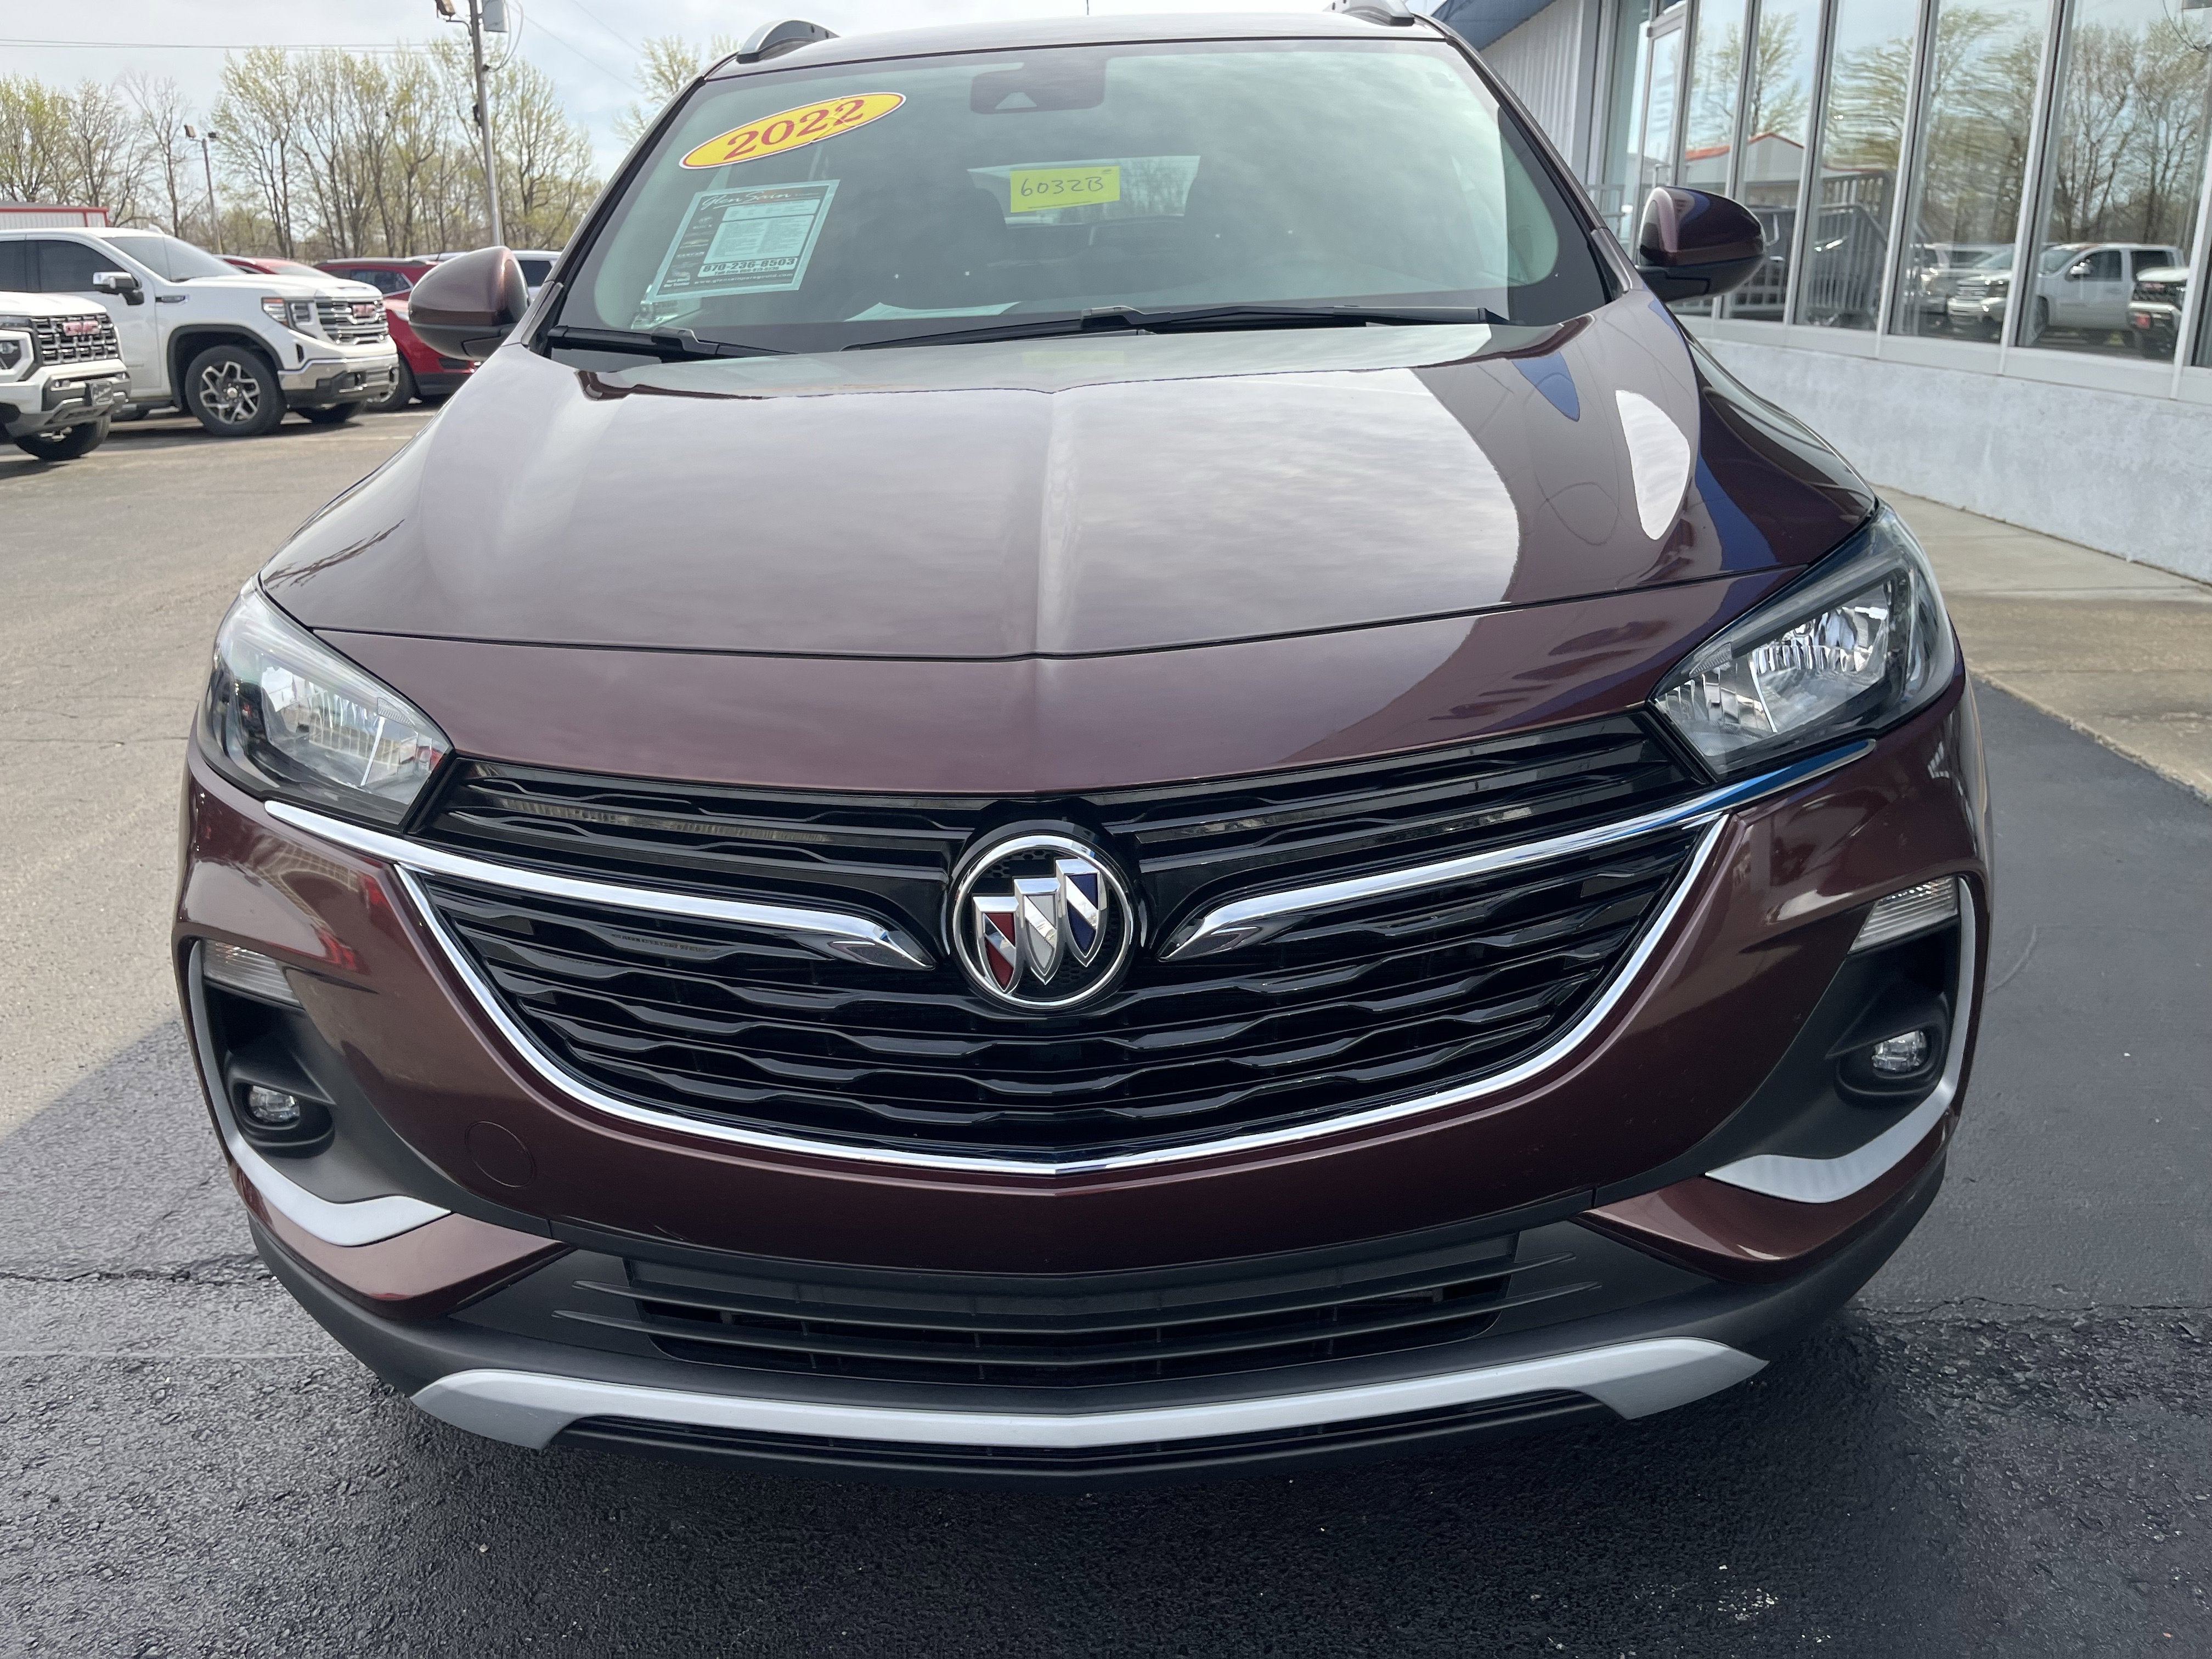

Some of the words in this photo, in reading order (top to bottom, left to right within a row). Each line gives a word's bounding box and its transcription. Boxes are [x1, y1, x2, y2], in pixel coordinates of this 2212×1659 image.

[723, 99, 864, 160] 2022
[1021, 176, 1103, 196] 6032B
[701, 195, 742, 210] Glen
[743, 191, 791, 203] Sain
[703, 258, 795, 272] 870-236-8503
